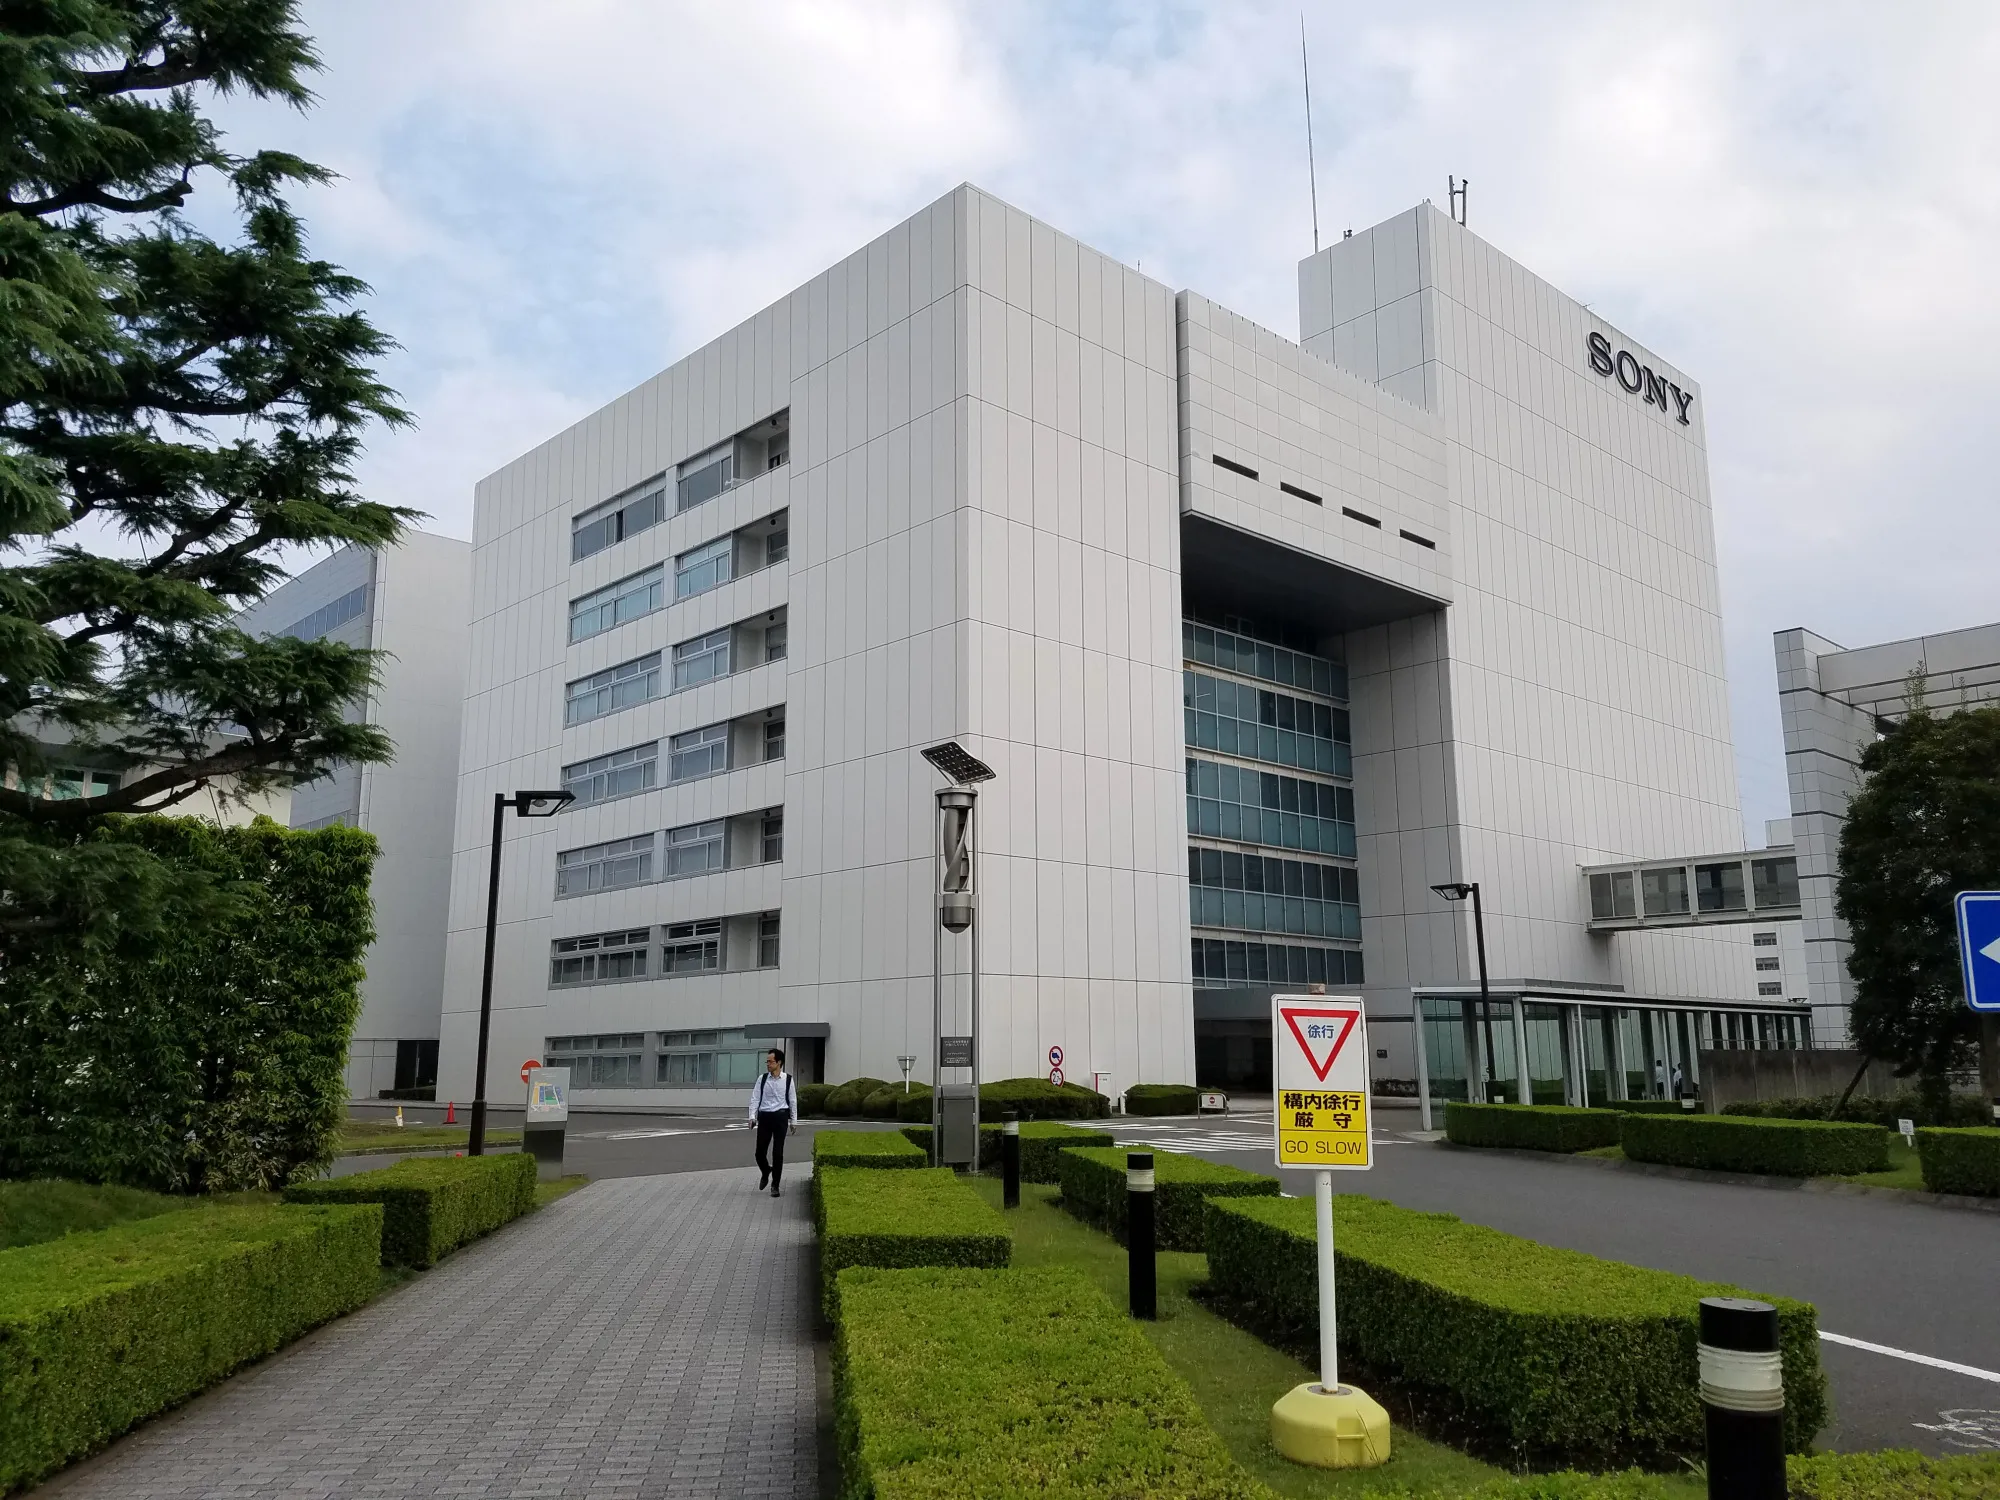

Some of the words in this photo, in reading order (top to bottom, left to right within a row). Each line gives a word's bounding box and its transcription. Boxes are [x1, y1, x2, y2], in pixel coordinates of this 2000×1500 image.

[1586, 331, 1694, 426] SONY
[1307, 1024, 1335, 1039] 徐行
[1283, 1092, 1361, 1111] 構内徐行
[1284, 1140, 1309, 1154] GO
[1315, 1141, 1362, 1155] SLOW
